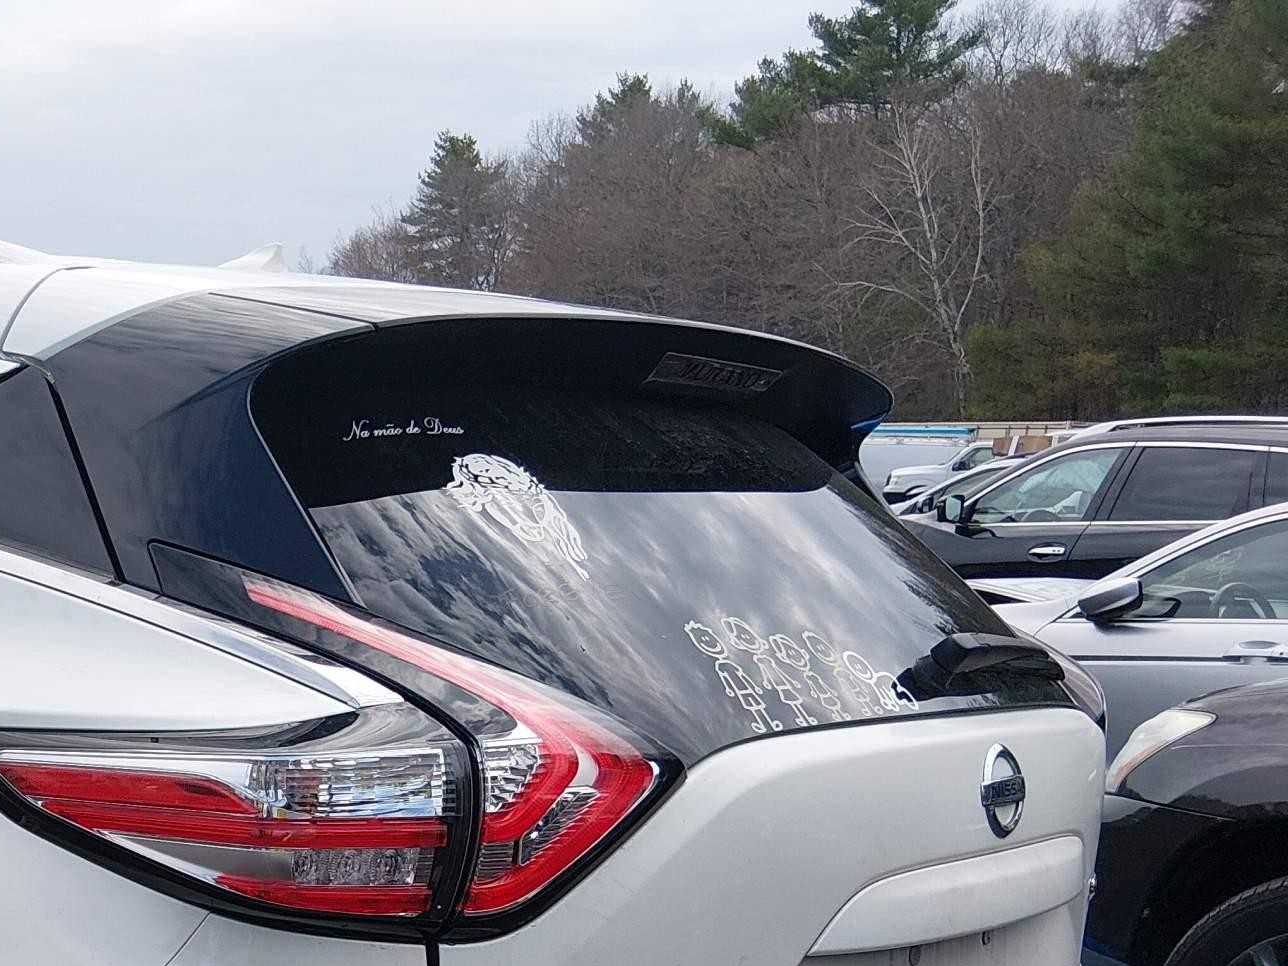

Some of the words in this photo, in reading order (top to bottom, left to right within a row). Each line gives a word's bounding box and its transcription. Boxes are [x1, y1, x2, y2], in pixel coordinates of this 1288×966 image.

[342, 418, 371, 442] Na
[372, 422, 404, 437] mão
[405, 418, 423, 435] de
[423, 415, 465, 435] Deus
